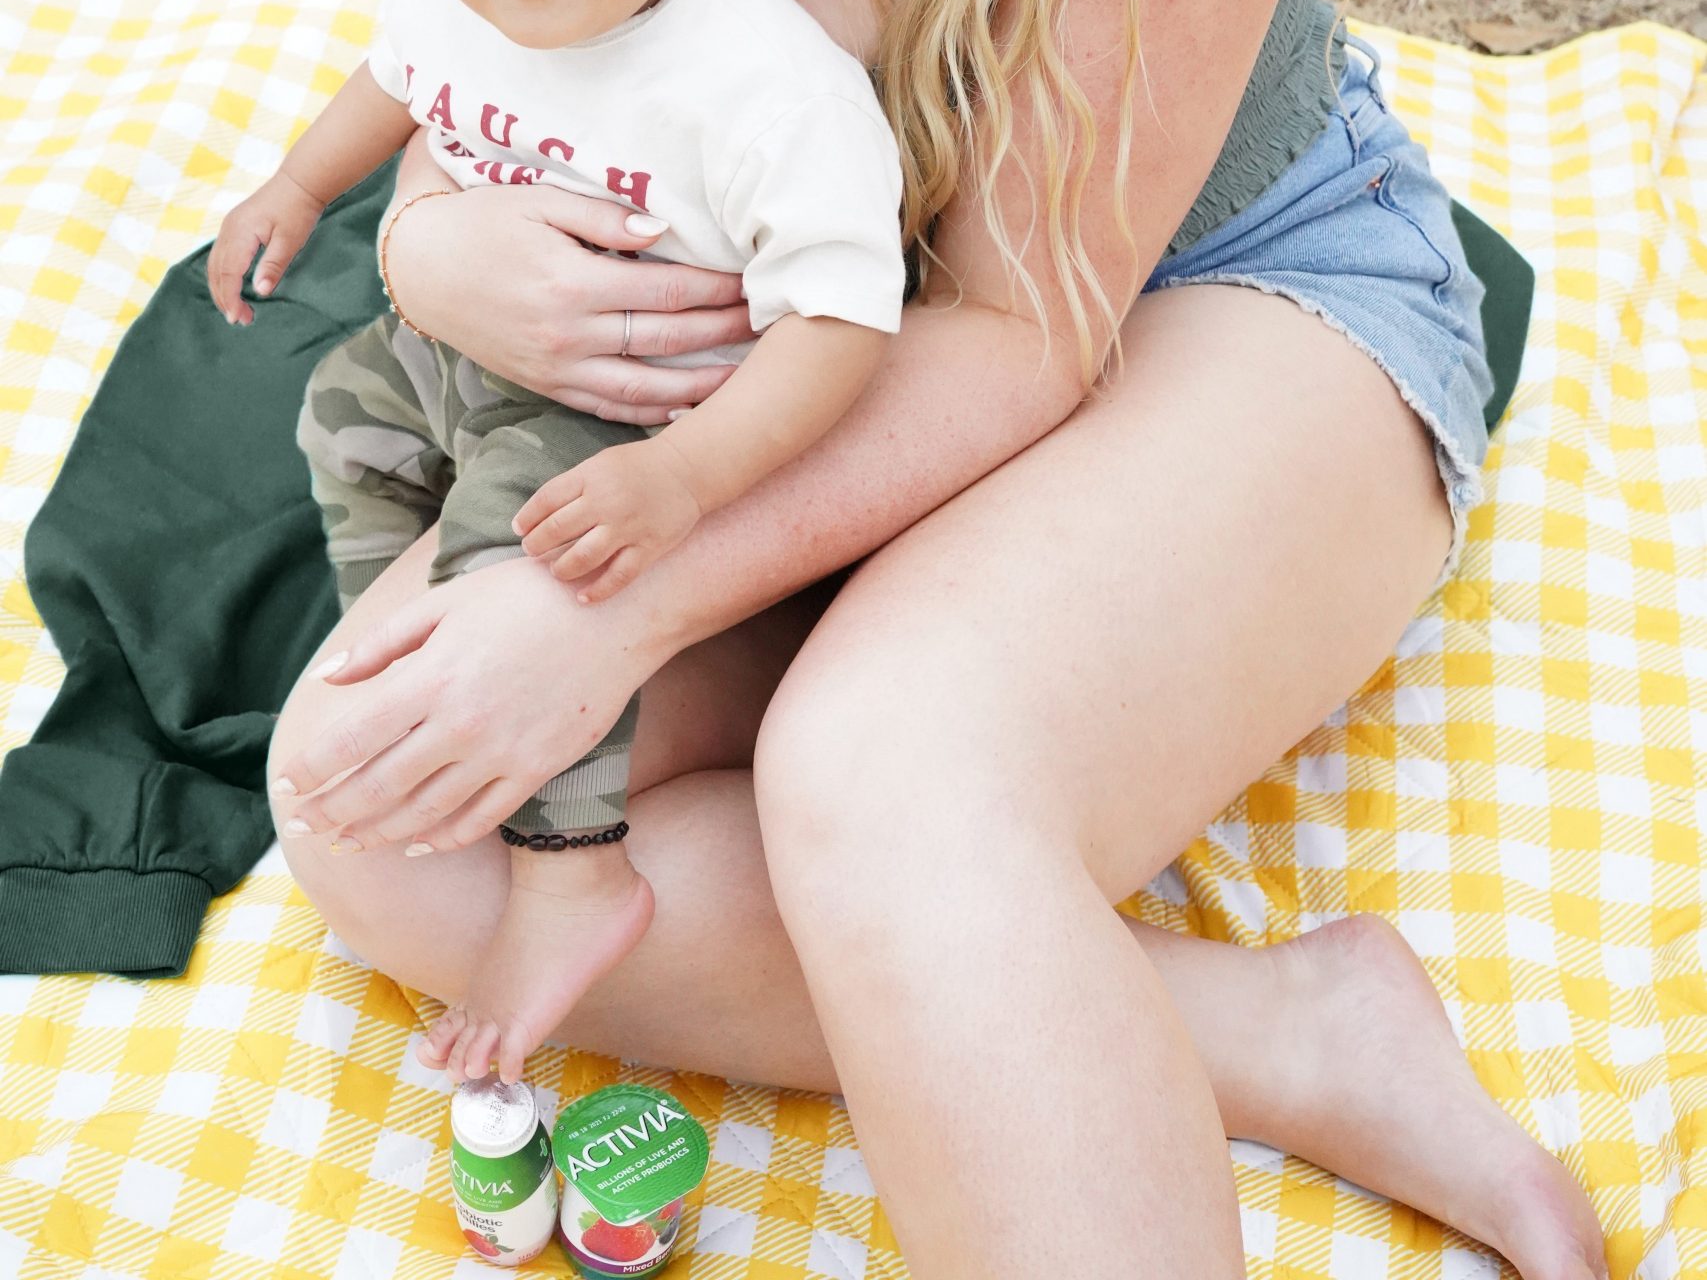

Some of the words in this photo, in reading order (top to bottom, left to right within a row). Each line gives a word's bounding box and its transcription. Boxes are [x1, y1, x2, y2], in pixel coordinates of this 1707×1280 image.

[406, 64, 652, 212] AUH
[567, 1103, 686, 1182] ACTIVIA
[596, 1165, 635, 1190] BILLIONS
[635, 1157, 648, 1169] OF
[647, 1148, 667, 1162] LIVE
[667, 1136, 686, 1152] AND
[452, 1159, 514, 1197] CTIVIA
[611, 1172, 643, 1195] ACTIVE
[641, 1147, 690, 1178] PROBIOTICS
[622, 1260, 654, 1273] Mixed
